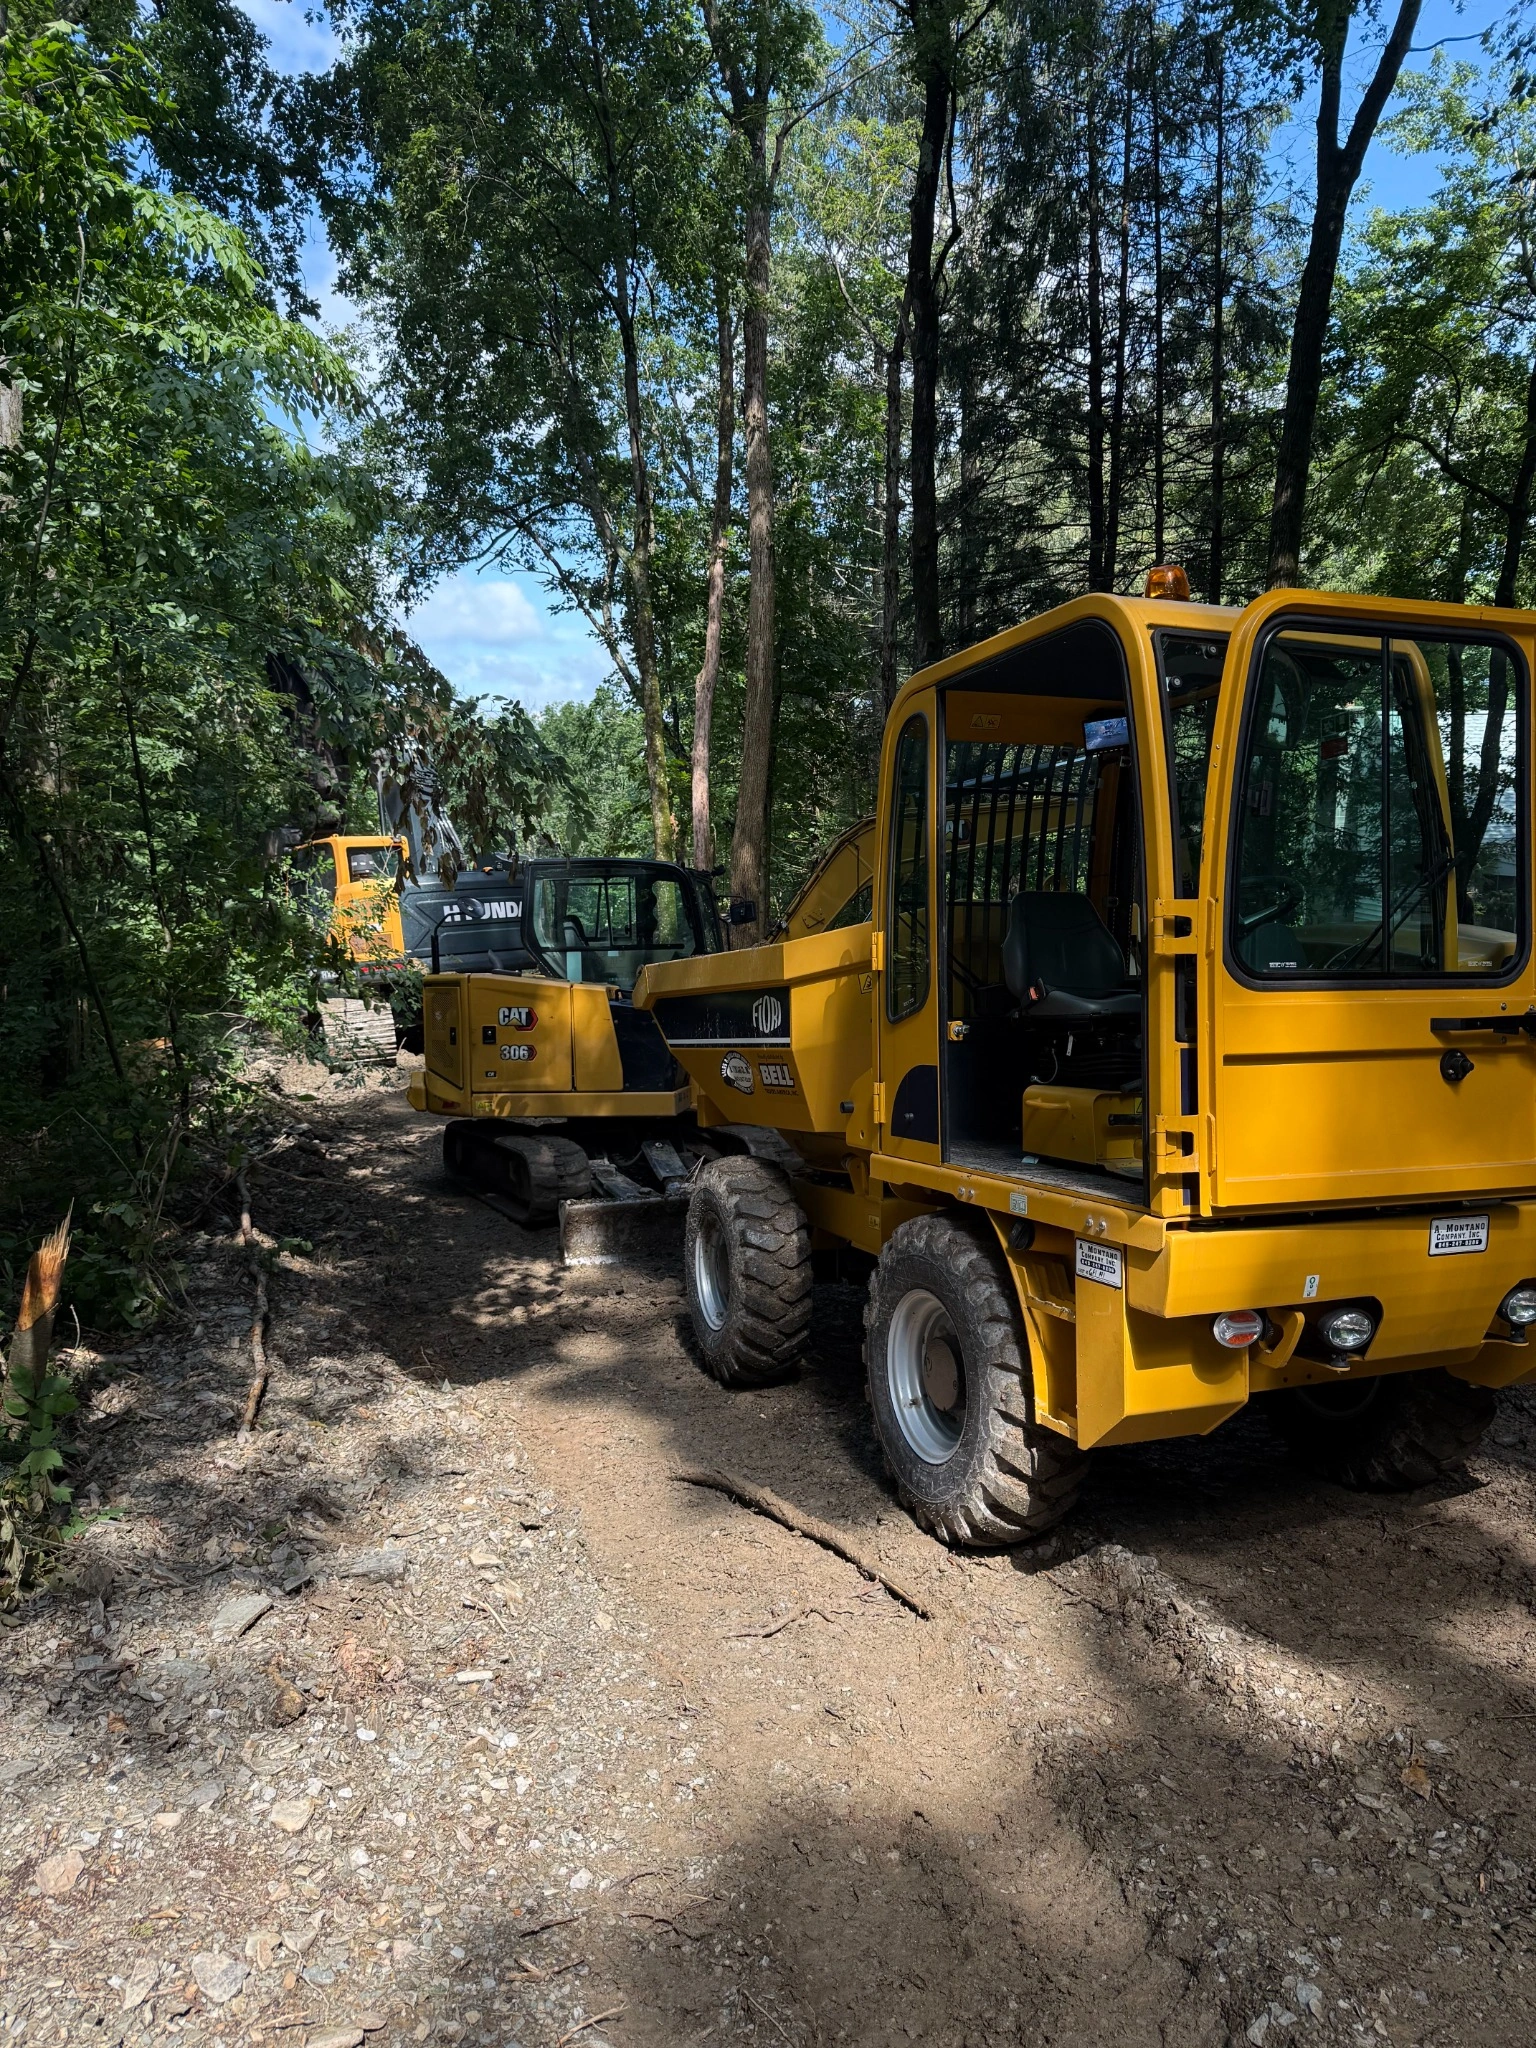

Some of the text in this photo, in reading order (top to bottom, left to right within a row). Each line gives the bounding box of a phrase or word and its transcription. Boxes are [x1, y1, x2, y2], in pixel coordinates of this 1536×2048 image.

[443, 901, 522, 922] HUND
[499, 1007, 528, 1026] CAT
[752, 995, 781, 1033] FIORI
[501, 1045, 529, 1060] 306
[760, 1065, 794, 1086] BELL
[1446, 1223, 1486, 1232] MONTANO
[1088, 1245, 1117, 1260] MONTANO
